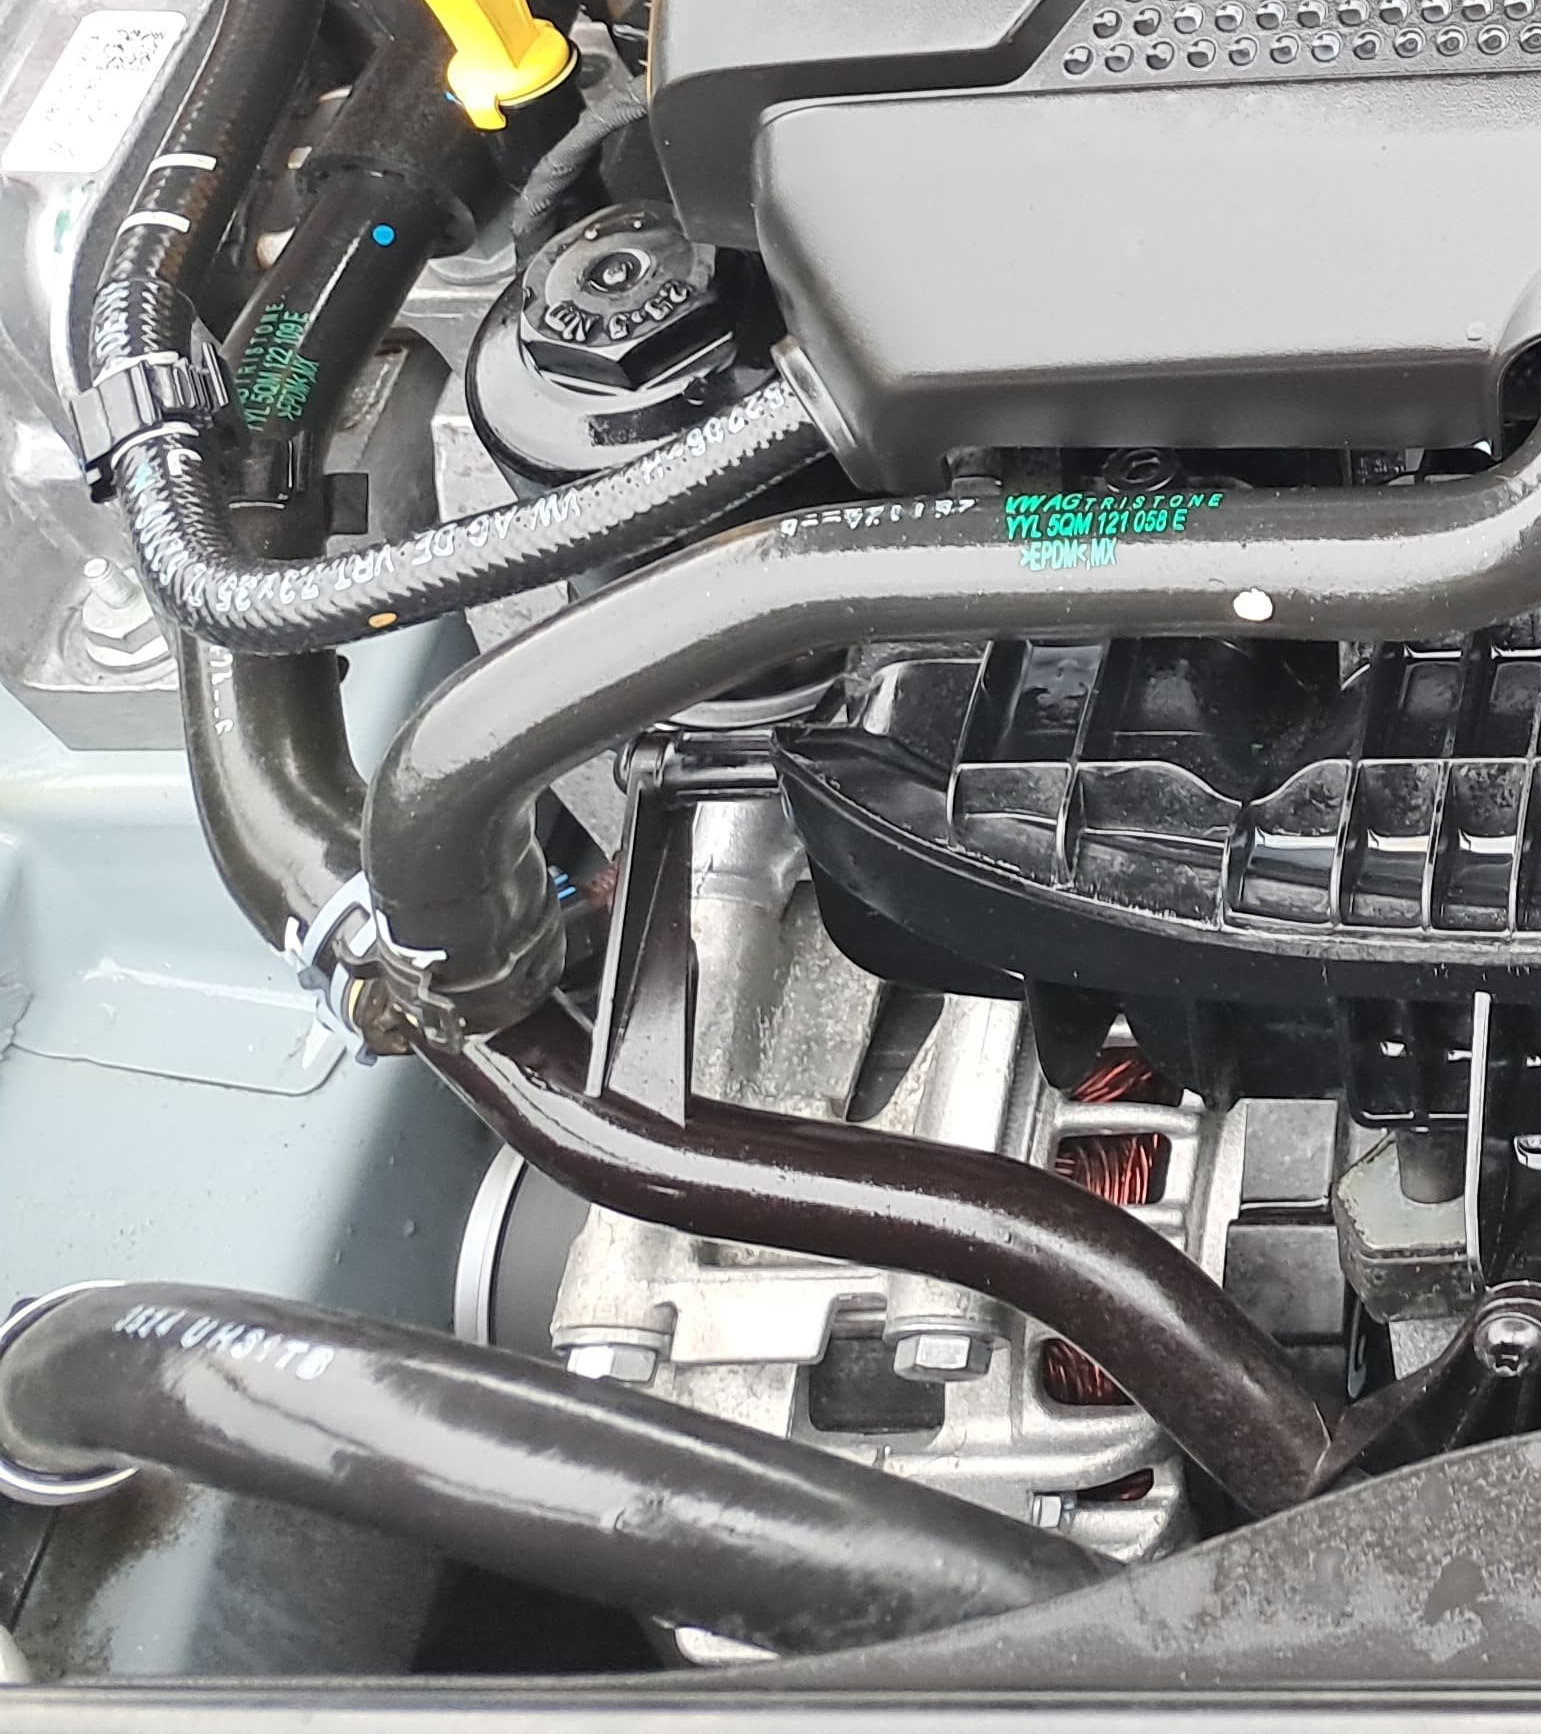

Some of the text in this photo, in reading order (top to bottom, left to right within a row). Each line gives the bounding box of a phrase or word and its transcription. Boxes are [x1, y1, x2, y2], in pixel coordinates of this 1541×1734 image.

[283, 309, 309, 323] E
[273, 319, 304, 346] 109
[263, 344, 293, 368] 122
[248, 369, 282, 404] 5QM
[1085, 494, 1224, 510] TRISTONE
[1005, 508, 1188, 539] YYL 5QM 121 058 E
[413, 523, 463, 567] DE
